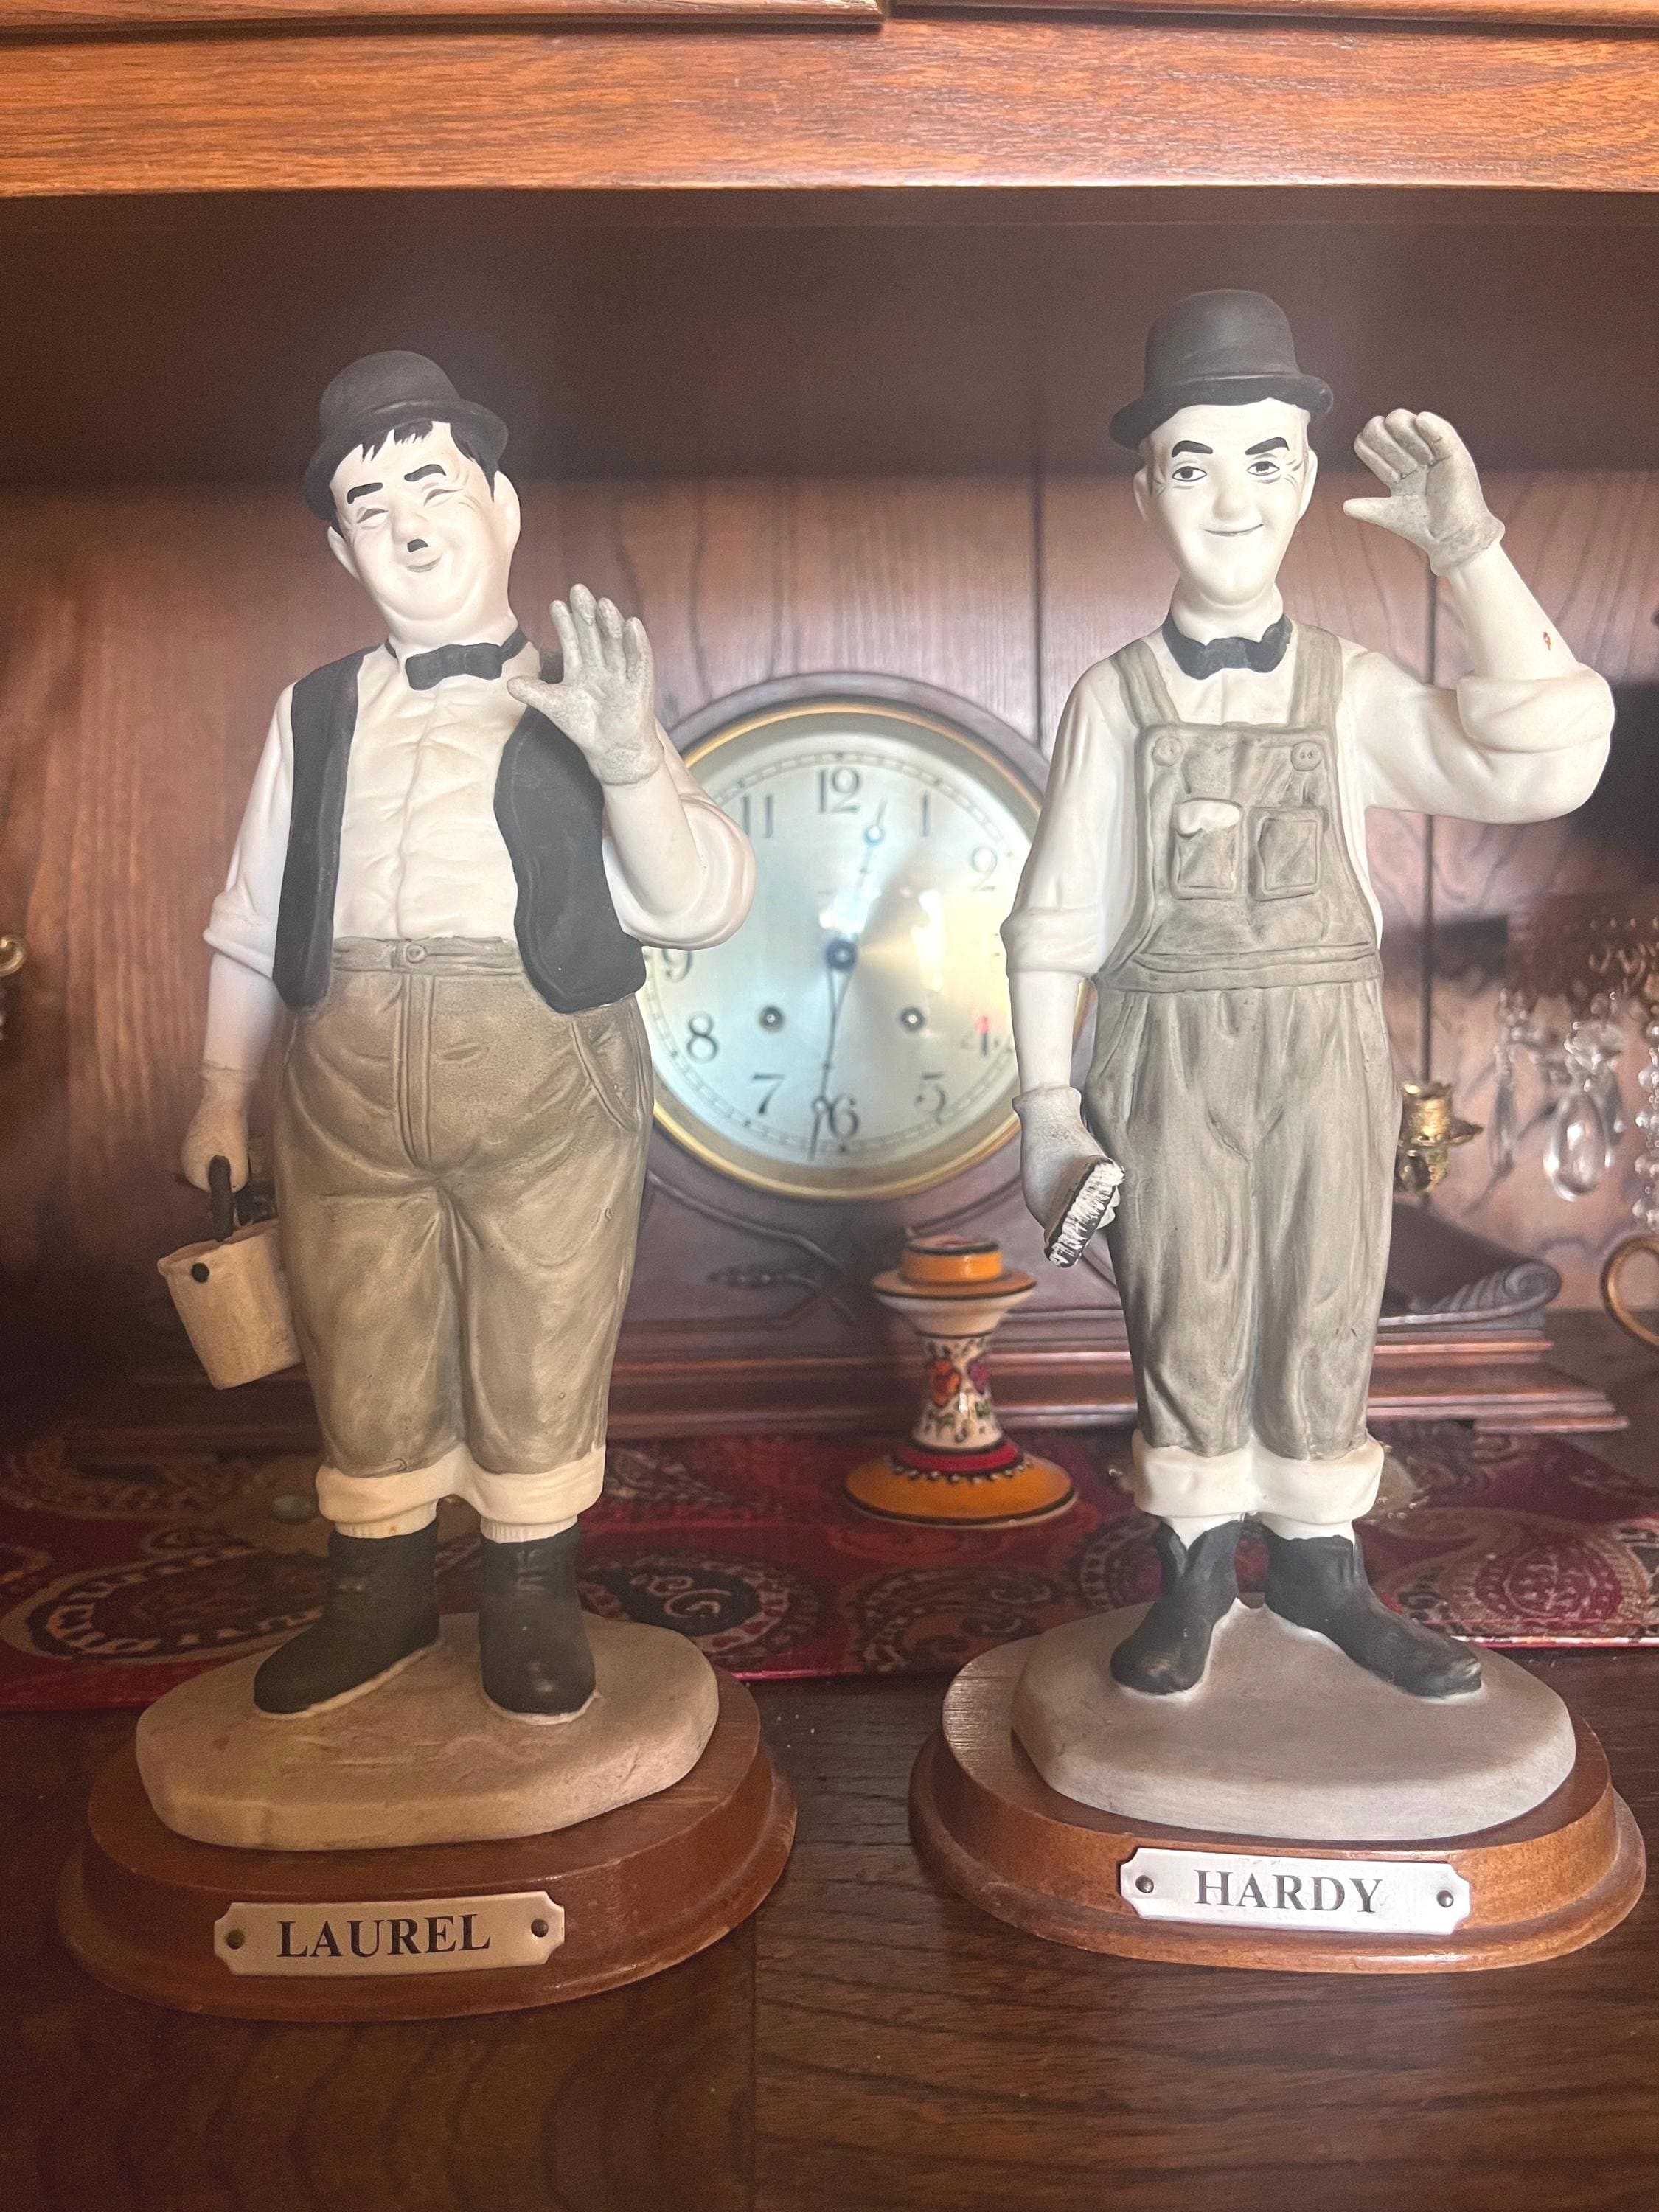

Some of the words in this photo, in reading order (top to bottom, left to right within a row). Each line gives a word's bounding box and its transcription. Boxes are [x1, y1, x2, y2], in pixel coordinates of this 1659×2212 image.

[817, 767, 861, 814] 12
[742, 794, 774, 839] 11
[919, 793, 930, 838] 1
[970, 846, 998, 892] 2
[686, 1011, 719, 1063] 8
[751, 1072, 785, 1116] 7
[827, 1093, 860, 1138] 6
[1194, 1868, 1383, 1913] HARDY
[276, 1913, 491, 1958] LAUREL
